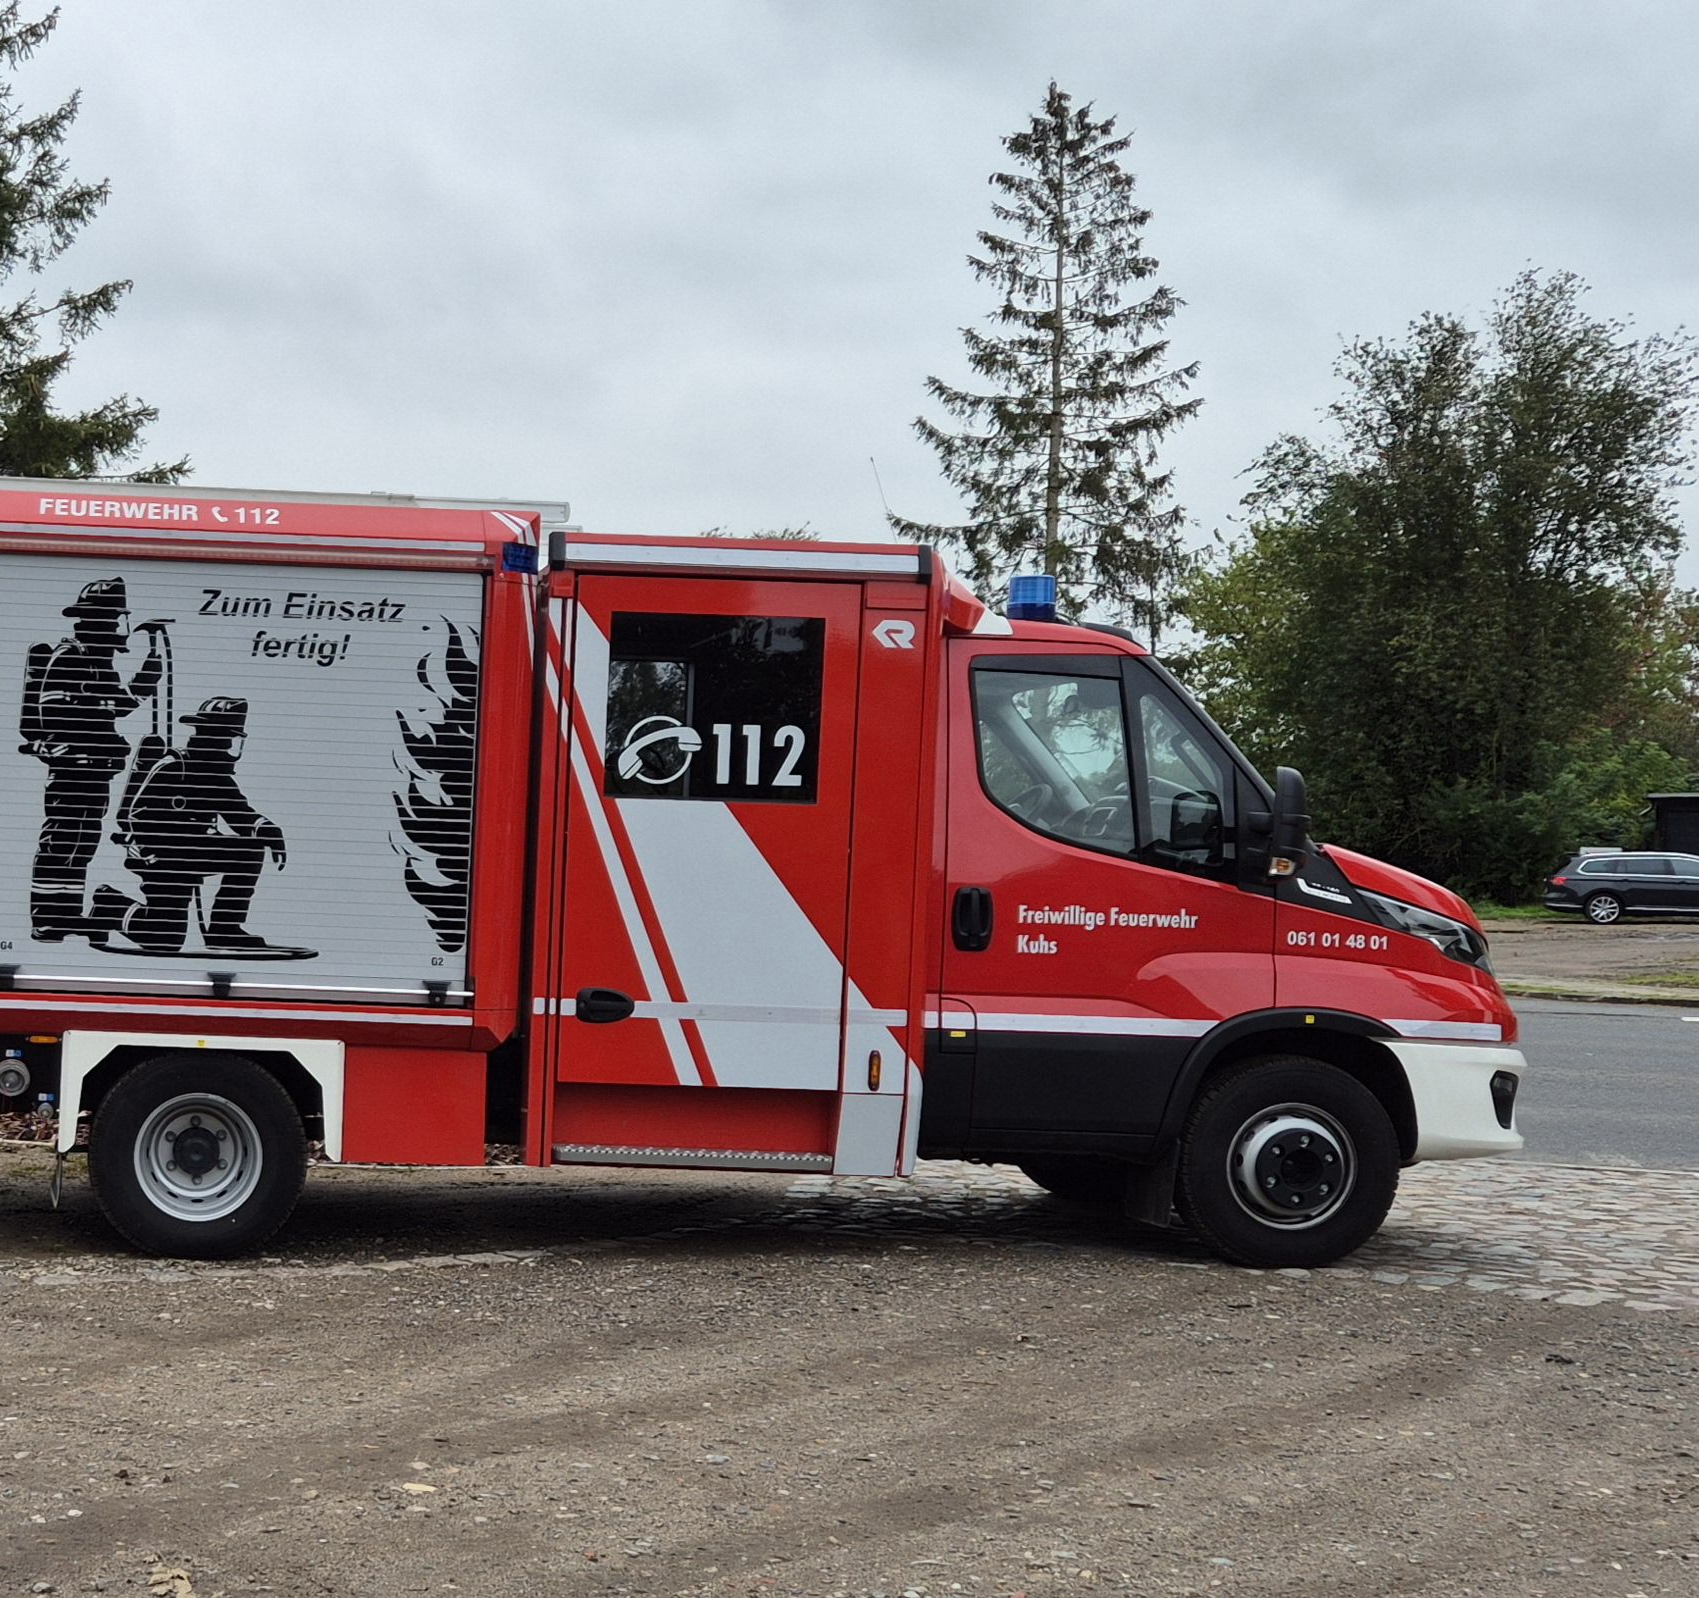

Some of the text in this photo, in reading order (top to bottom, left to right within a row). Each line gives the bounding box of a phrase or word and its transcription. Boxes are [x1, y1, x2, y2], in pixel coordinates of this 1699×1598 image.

[39, 498, 281, 525] FEUERWEHR 112
[198, 589, 406, 622] Zum Einsatz
[251, 631, 351, 667] fertig!
[713, 723, 806, 786] 112
[1018, 904, 1199, 931] Freiwillige Feuerwehr
[0, 941, 12, 950] G4
[1017, 934, 1058, 954] Kuhs
[1287, 931, 1388, 950] 061 01 48 01
[431, 956, 444, 966] G2
